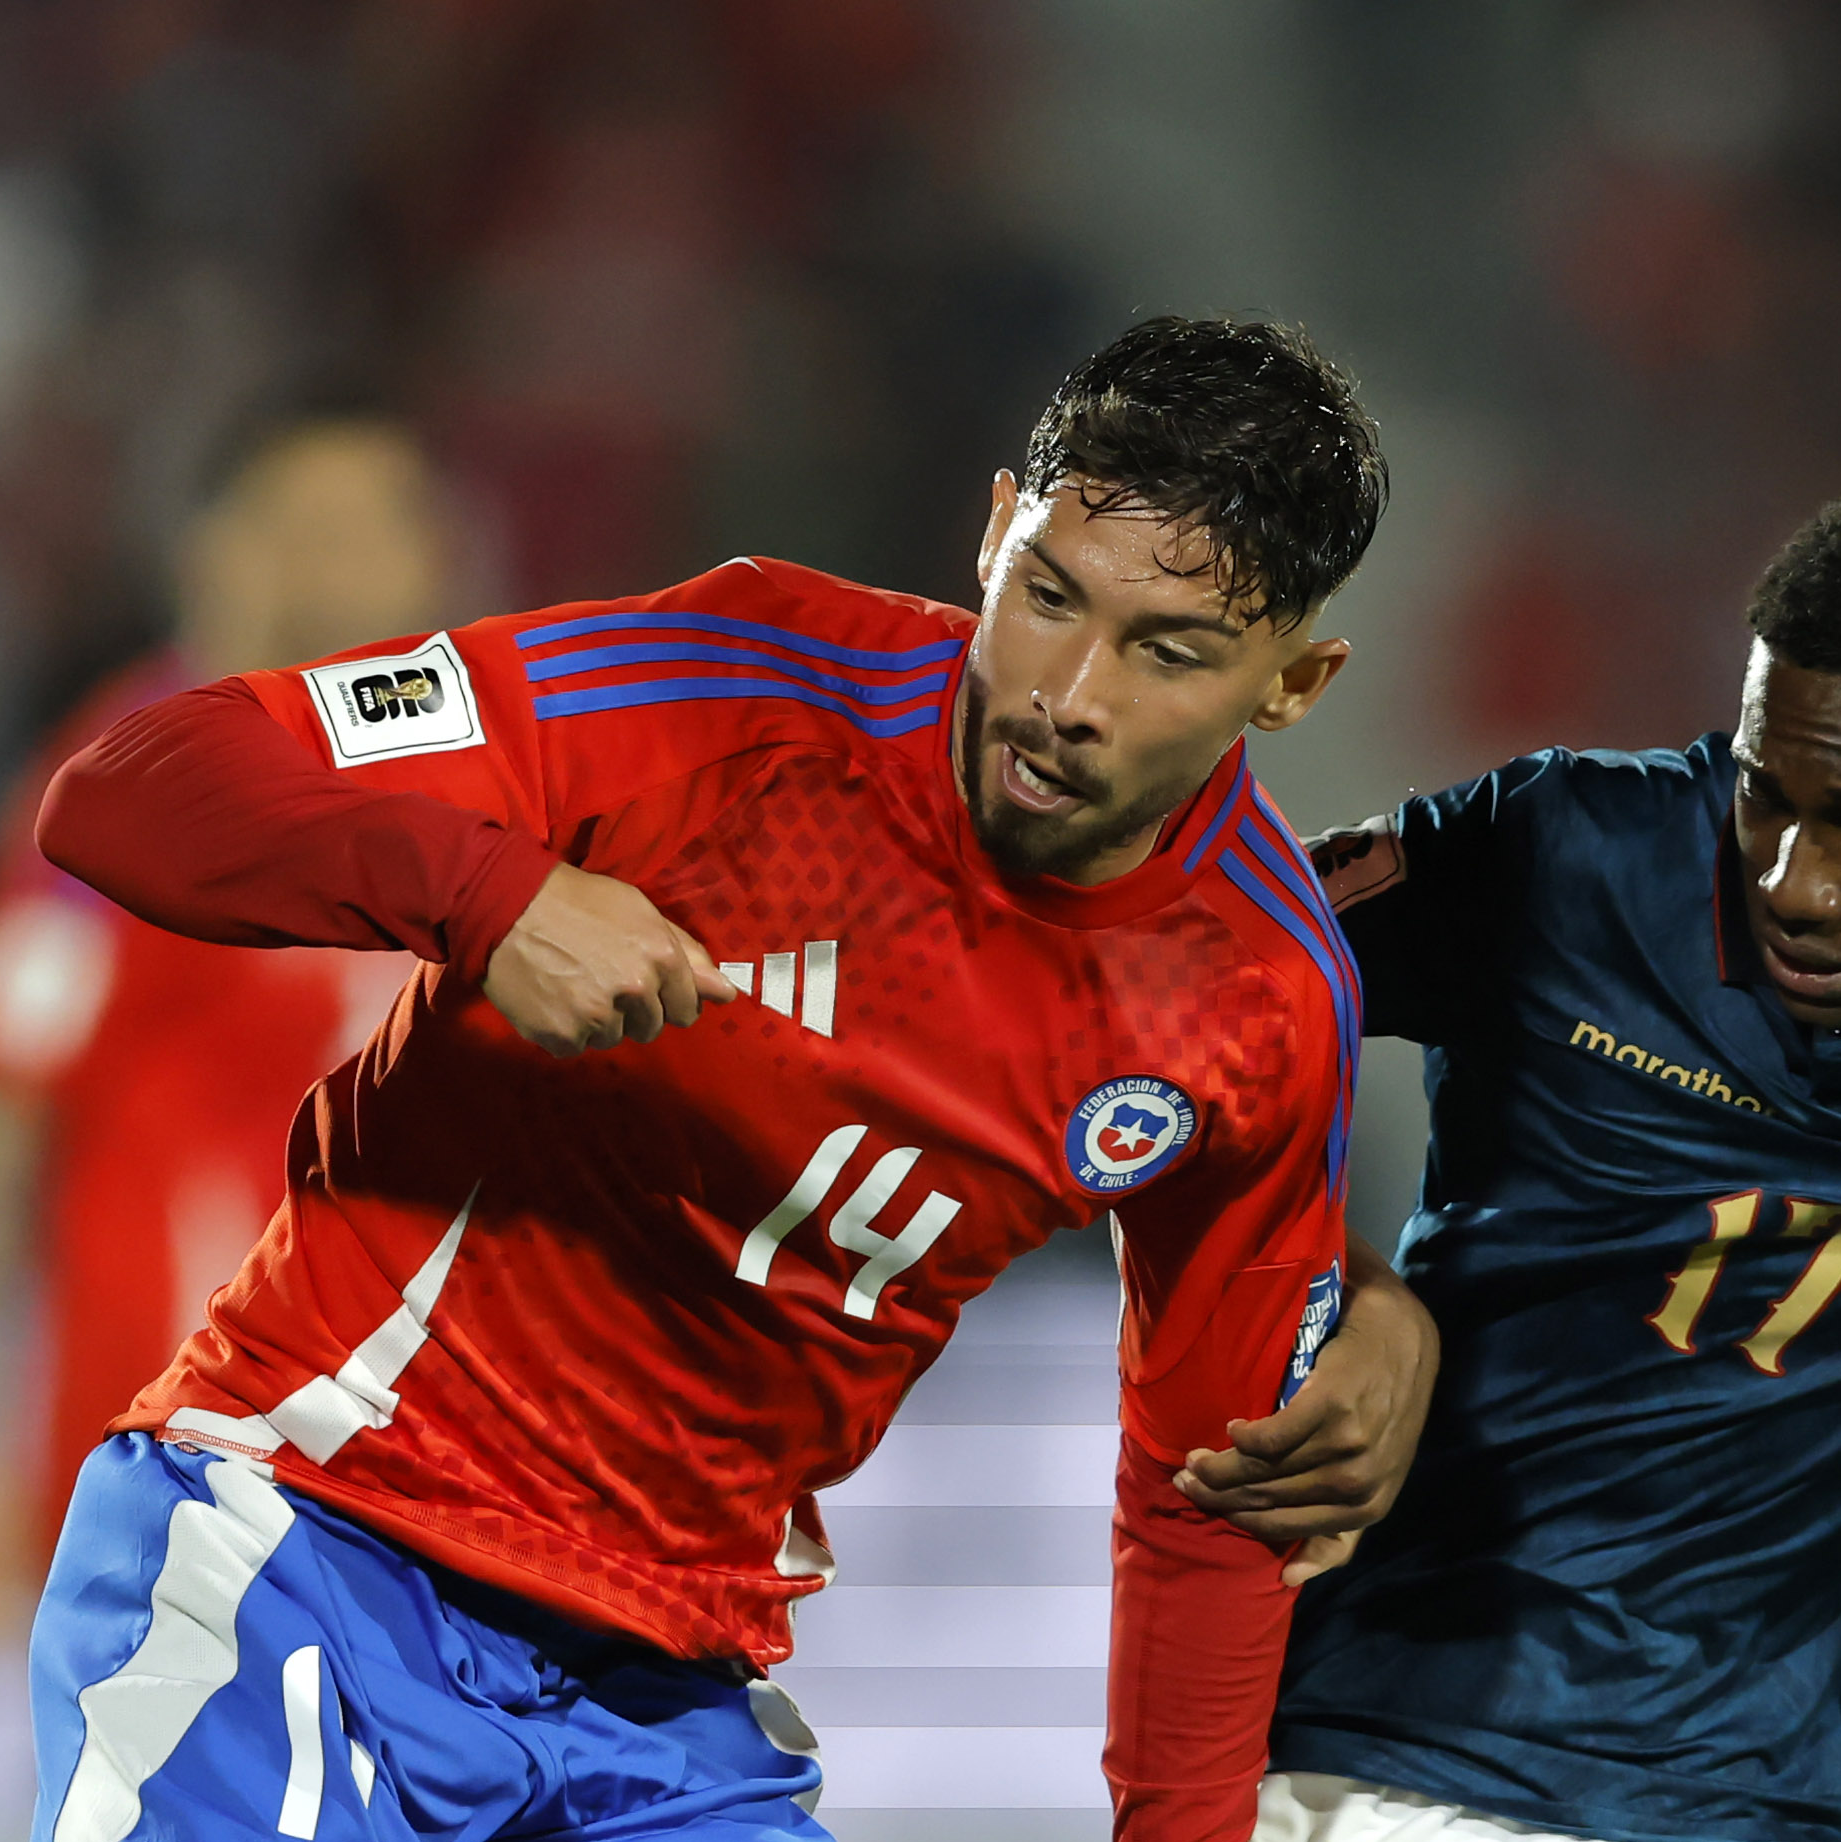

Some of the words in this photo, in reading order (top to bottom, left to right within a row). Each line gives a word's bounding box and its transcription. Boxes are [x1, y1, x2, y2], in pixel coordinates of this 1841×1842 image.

[337, 681, 359, 727] QUALIFIERS
[359, 686, 376, 712] FIFA
[1078, 1079, 1162, 1121] FEDERACION
[1165, 1089, 1186, 1106] DE
[1171, 1107, 1194, 1147] FUTBOL
[1078, 1163, 1098, 1182] DE
[1098, 1173, 1134, 1188] CHILE
[734, 1124, 963, 1320] 14
